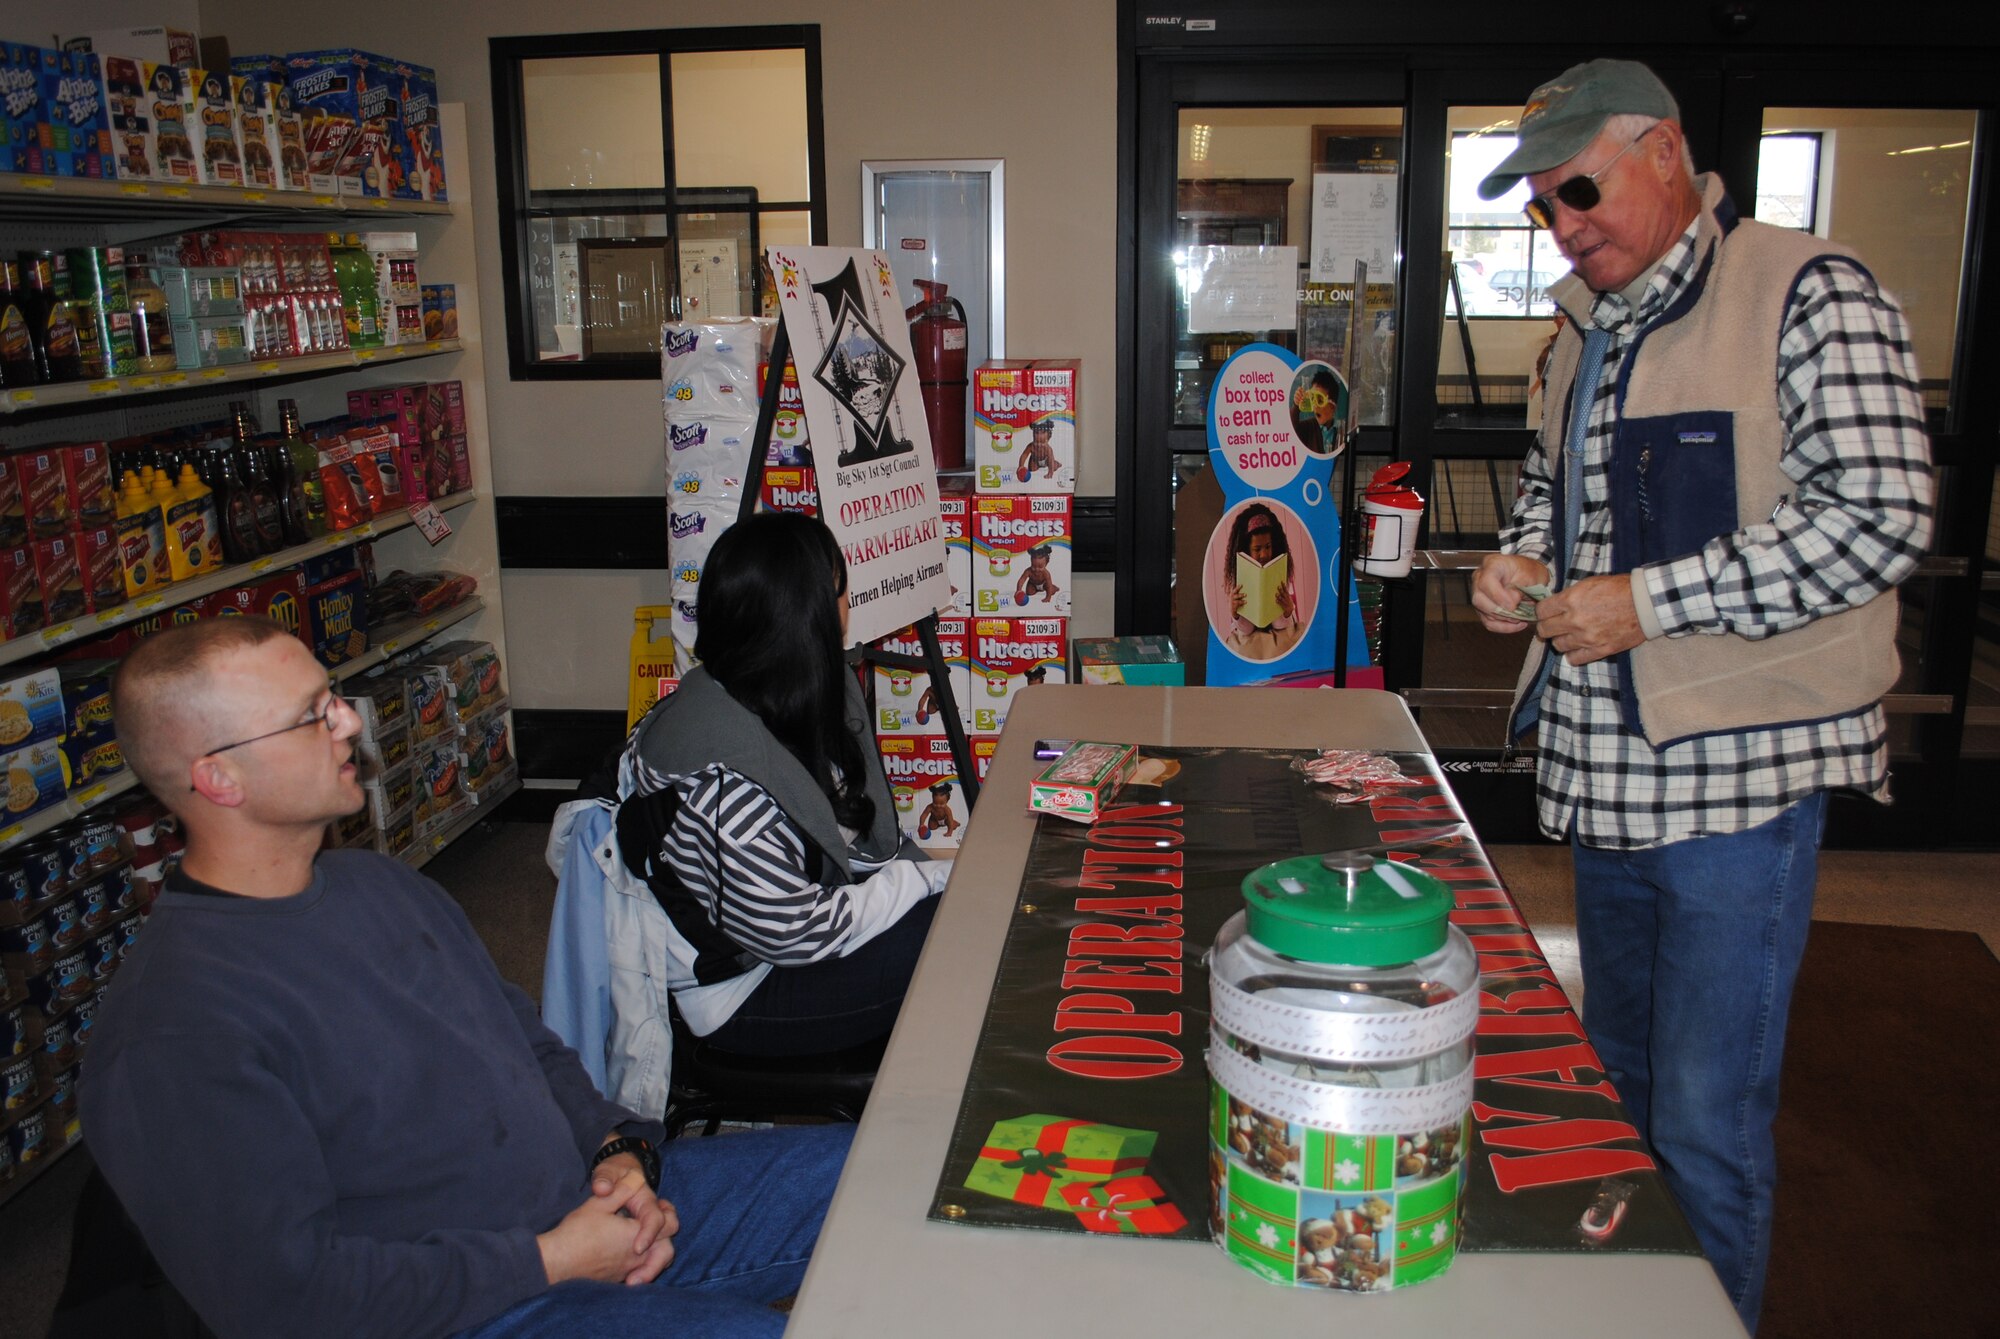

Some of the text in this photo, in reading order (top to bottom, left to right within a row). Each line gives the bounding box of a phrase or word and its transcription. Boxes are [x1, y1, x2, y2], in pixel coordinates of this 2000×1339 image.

[1146, 17, 1182, 25] STANLEY
[296, 70, 335, 90] FROSTED
[57, 78, 98, 104] Alpha
[298, 81, 331, 101] FLAKES
[360, 87, 388, 108] FROSTED
[68, 98, 99, 125] Bits
[363, 101, 386, 120] FLAKES
[404, 95, 429, 114] FROSTED
[406, 108, 428, 126] FLAKES
[1297, 289, 1325, 301] EXIT
[669, 329, 693, 351] Scott
[1035, 375, 1068, 386] 52109 31
[1239, 371, 1275, 384] collect
[675, 388, 693, 401] 48
[982, 389, 1068, 412] HUGGIES
[1225, 387, 1286, 407] box tops
[1219, 409, 1271, 427] to earn
[675, 422, 702, 443] Scott
[1227, 431, 1290, 446] cash for our
[1239, 446, 1297, 470] school
[836, 472, 852, 488] Big
[852, 468, 867, 484] Sky
[881, 463, 893, 478] Sgt
[893, 455, 920, 473] Council
[984, 467, 996, 481] 3
[682, 481, 700, 494] 48
[772, 488, 817, 507] HUGG
[840, 482, 927, 528] OPERATION
[1032, 501, 1065, 511] 52109 31
[939, 503, 952, 513] 109
[953, 503, 963, 513] 31
[673, 511, 700, 532] Scott
[981, 515, 1065, 538] HUGGIES
[840, 516, 939, 567] WARM-HEART
[296, 572, 306, 588] 10
[681, 569, 699, 582] 48
[848, 562, 944, 609] irmen Helping Airmen
[236, 591, 249, 603] 10
[983, 592, 994, 606] 3
[319, 593, 354, 621] Honey
[682, 604, 697, 617] Sco
[325, 612, 353, 640] Maid
[936, 623, 963, 632] 2109 31
[1027, 624, 1059, 634] 52109 31
[882, 637, 964, 658] HUGES
[978, 637, 1059, 660] HUGGIES
[637, 663, 674, 678] CAUTI
[886, 710, 896, 724] 3
[980, 710, 991, 724] 3
[83, 823, 115, 837] ARMOU
[83, 883, 105, 897] ARMO
[53, 900, 77, 915] ARMO
[21, 919, 46, 936] ARMO
[1046, 802, 1184, 1080] OPERATION
[54, 951, 87, 969] ARMOU
[8, 1069, 34, 1087] Has
[18, 1111, 45, 1129] ARMO
[24, 1122, 46, 1140] Ha
